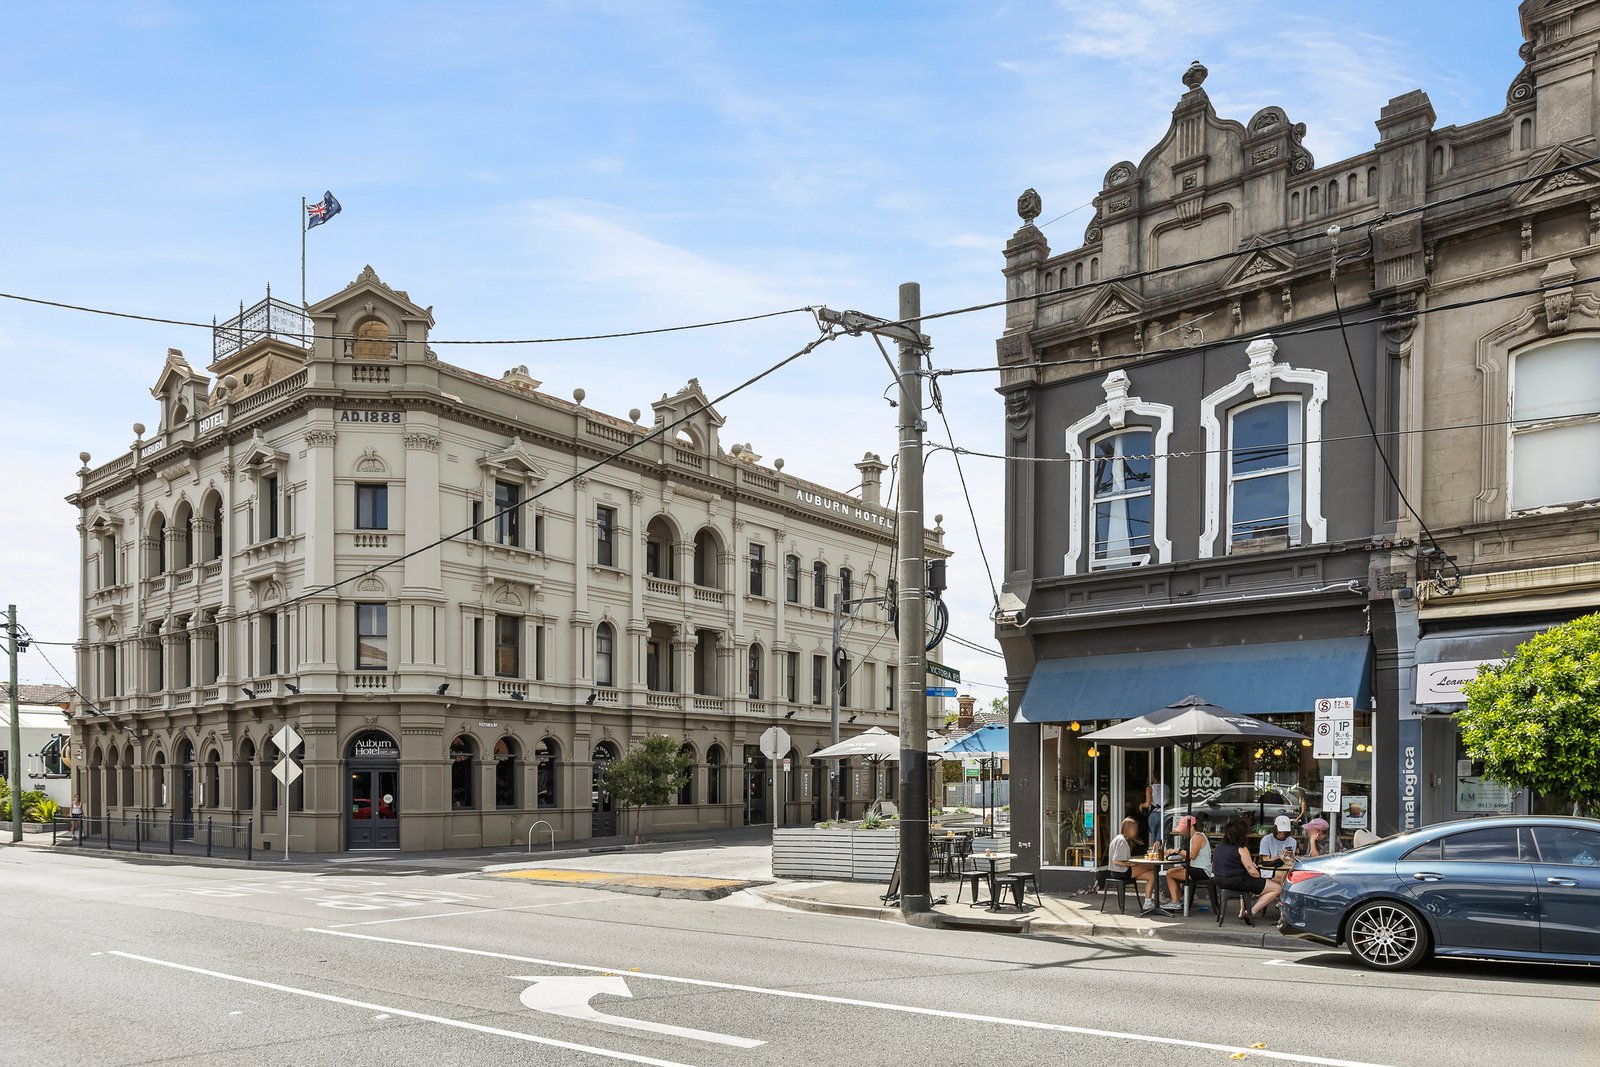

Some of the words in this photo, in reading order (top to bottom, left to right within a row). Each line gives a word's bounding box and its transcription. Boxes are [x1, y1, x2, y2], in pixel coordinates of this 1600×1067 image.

[199, 411, 224, 433] HOTEL
[796, 490, 849, 515] AUBURN
[855, 508, 893, 528] HOTEL
[929, 665, 952, 680] VICTORIA
[952, 673, 960, 682] RD
[1339, 721, 1350, 732] 1P
[355, 739, 391, 748] Auburn
[355, 747, 380, 756] Hotel
[1402, 746, 1417, 830] malogica
